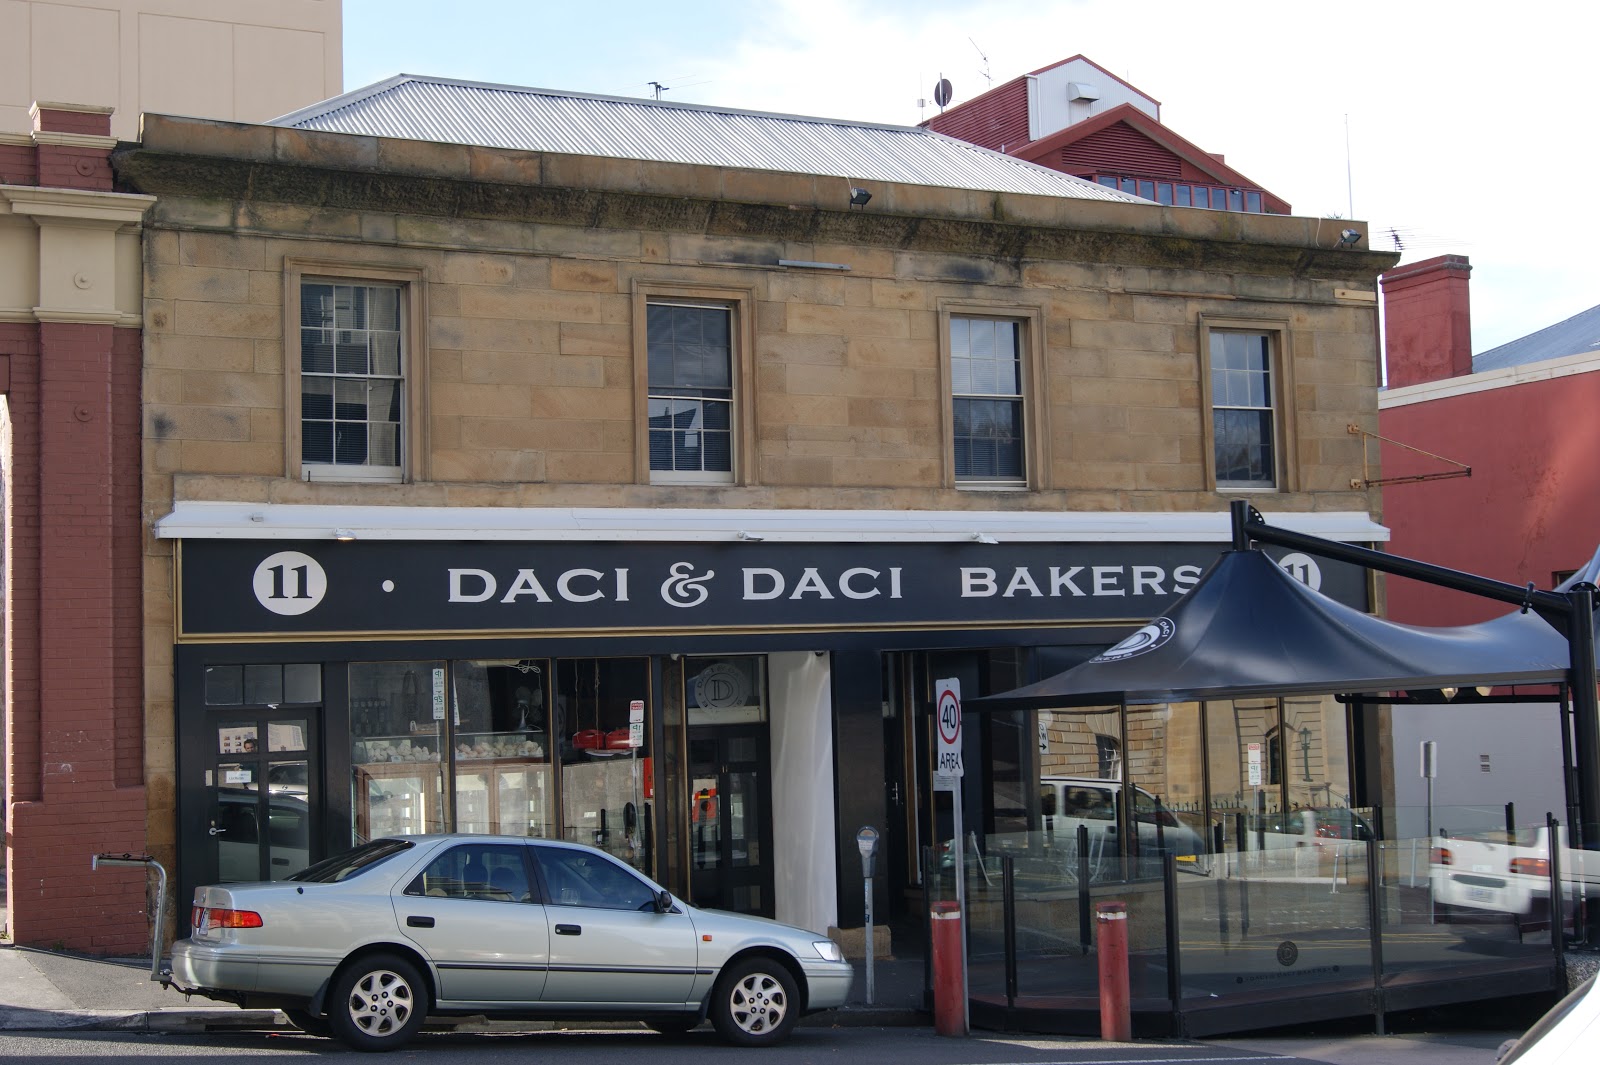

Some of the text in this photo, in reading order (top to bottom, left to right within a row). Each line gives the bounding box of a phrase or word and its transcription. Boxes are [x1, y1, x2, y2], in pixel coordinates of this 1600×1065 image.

[267, 564, 313, 599] 11
[448, 567, 629, 603] DACI
[660, 561, 715, 608] &
[741, 566, 902, 600] DACI
[959, 564, 1203, 599] BAKERS
[942, 704, 957, 729] 40
[939, 752, 960, 770] AREA
